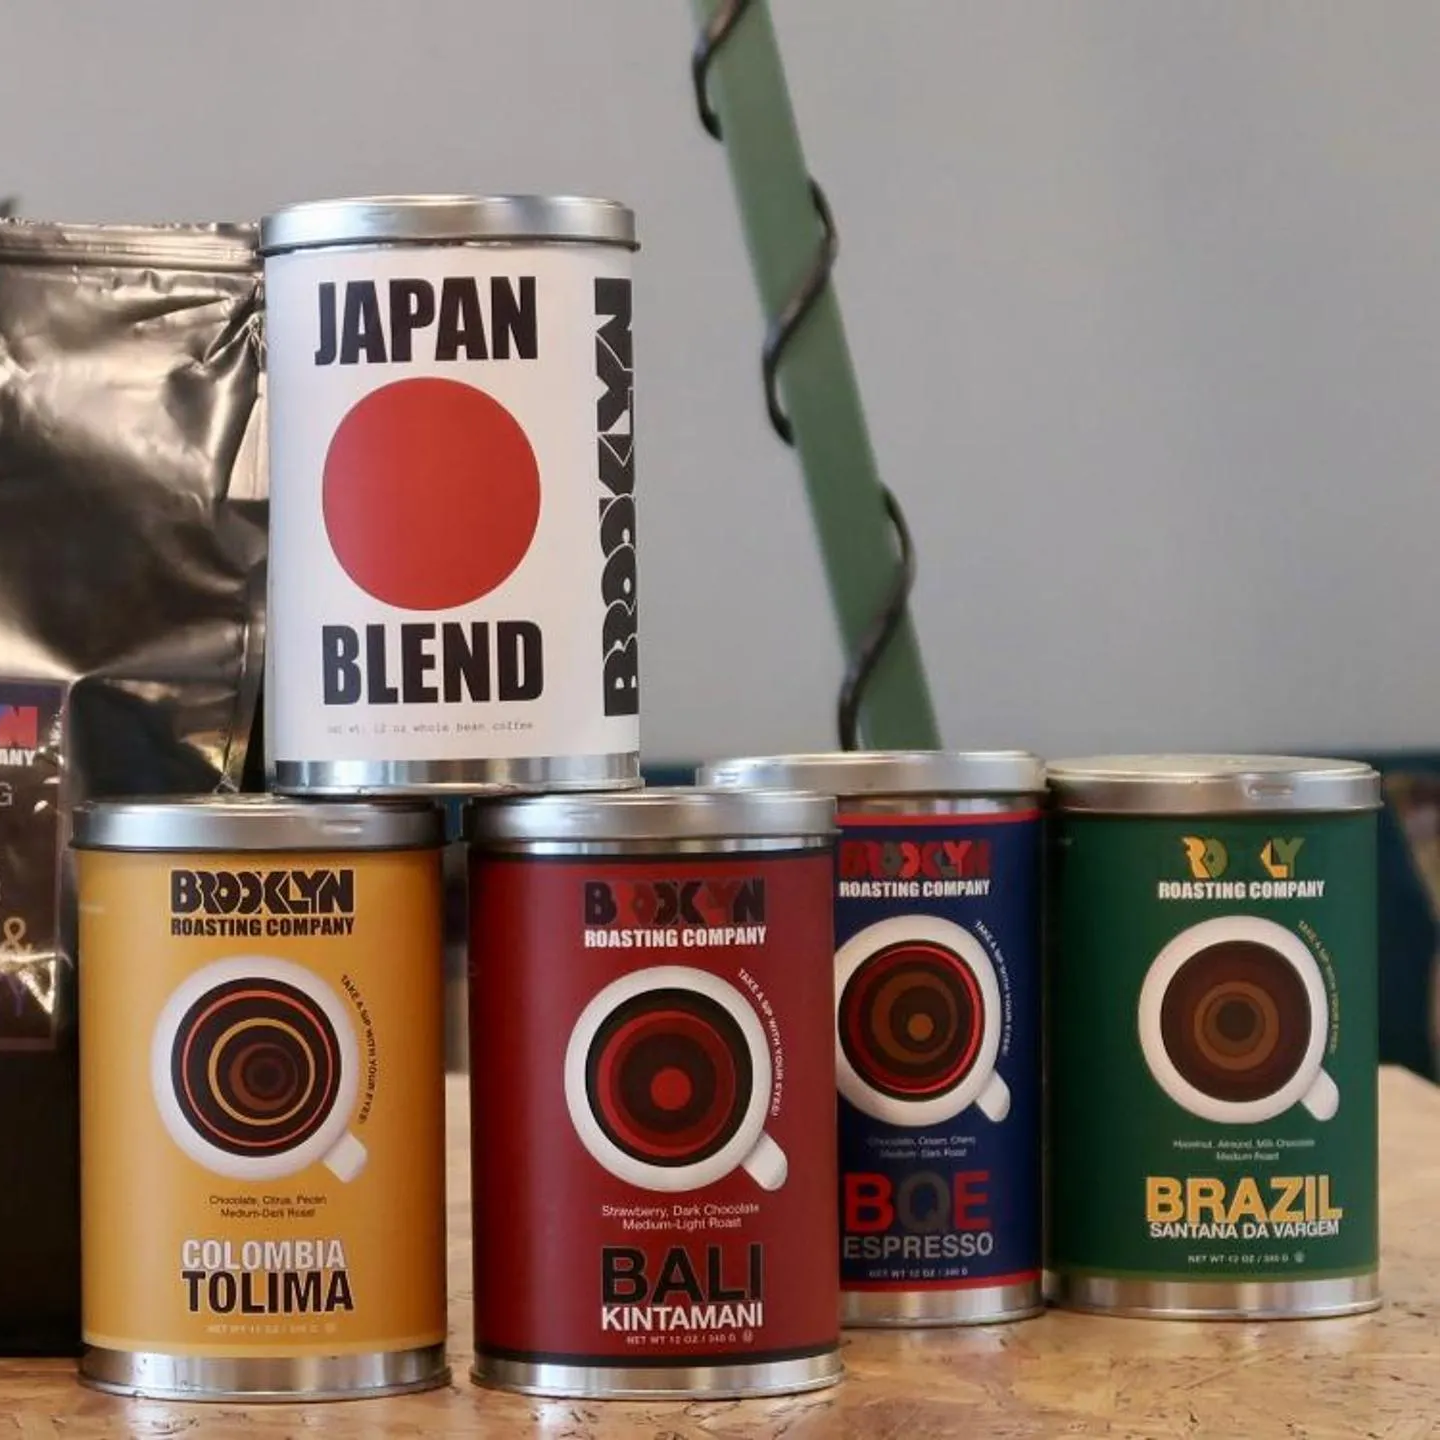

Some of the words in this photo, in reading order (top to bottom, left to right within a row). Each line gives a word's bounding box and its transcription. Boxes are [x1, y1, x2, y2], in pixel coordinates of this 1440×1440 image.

[314, 276, 539, 365] JAPAN
[594, 277, 640, 717] BROOKLYN
[322, 620, 544, 705] BLEND
[413, 722, 450, 734] whole
[456, 721, 485, 733] bean
[491, 720, 533, 732] coffee
[170, 868, 355, 915] BROOKLYN
[584, 877, 766, 926] BROOKLYN
[839, 880, 920, 898] ROASTING
[923, 879, 990, 897] COMPANY
[1158, 881, 1247, 900] ROASTING
[1249, 880, 1326, 899] COMPANY
[171, 917, 261, 936] ROASTING
[266, 916, 355, 936] COMPANY
[584, 928, 678, 948] ROASTING
[682, 926, 767, 947] COMPANY
[341, 974, 360, 1001] TAKE
[738, 967, 760, 994] TAKE
[769, 1017, 781, 1046] WITH
[774, 1047, 785, 1081] YOUR
[602, 1204, 669, 1219] Strawberry,
[673, 1204, 701, 1217] Dark
[704, 1202, 760, 1217] Chocolate
[843, 1170, 992, 1233] BQE
[1145, 1174, 1343, 1224] BRAZIL
[623, 1217, 707, 1232] Medium-Light
[709, 1216, 743, 1229] Roast
[1149, 1221, 1237, 1239] SANTANA
[1243, 1221, 1267, 1239] DA
[1273, 1220, 1339, 1238] VARGEM
[182, 1239, 347, 1270] COLOMBIA
[843, 1231, 994, 1260] ESPRESSO
[602, 1244, 765, 1304] BALI
[182, 1270, 355, 1315] TOLIMA
[602, 1302, 763, 1331] KINTAMANI
[626, 1335, 647, 1345] NET
[650, 1335, 666, 1345] WT
[684, 1334, 699, 1344] OZ
